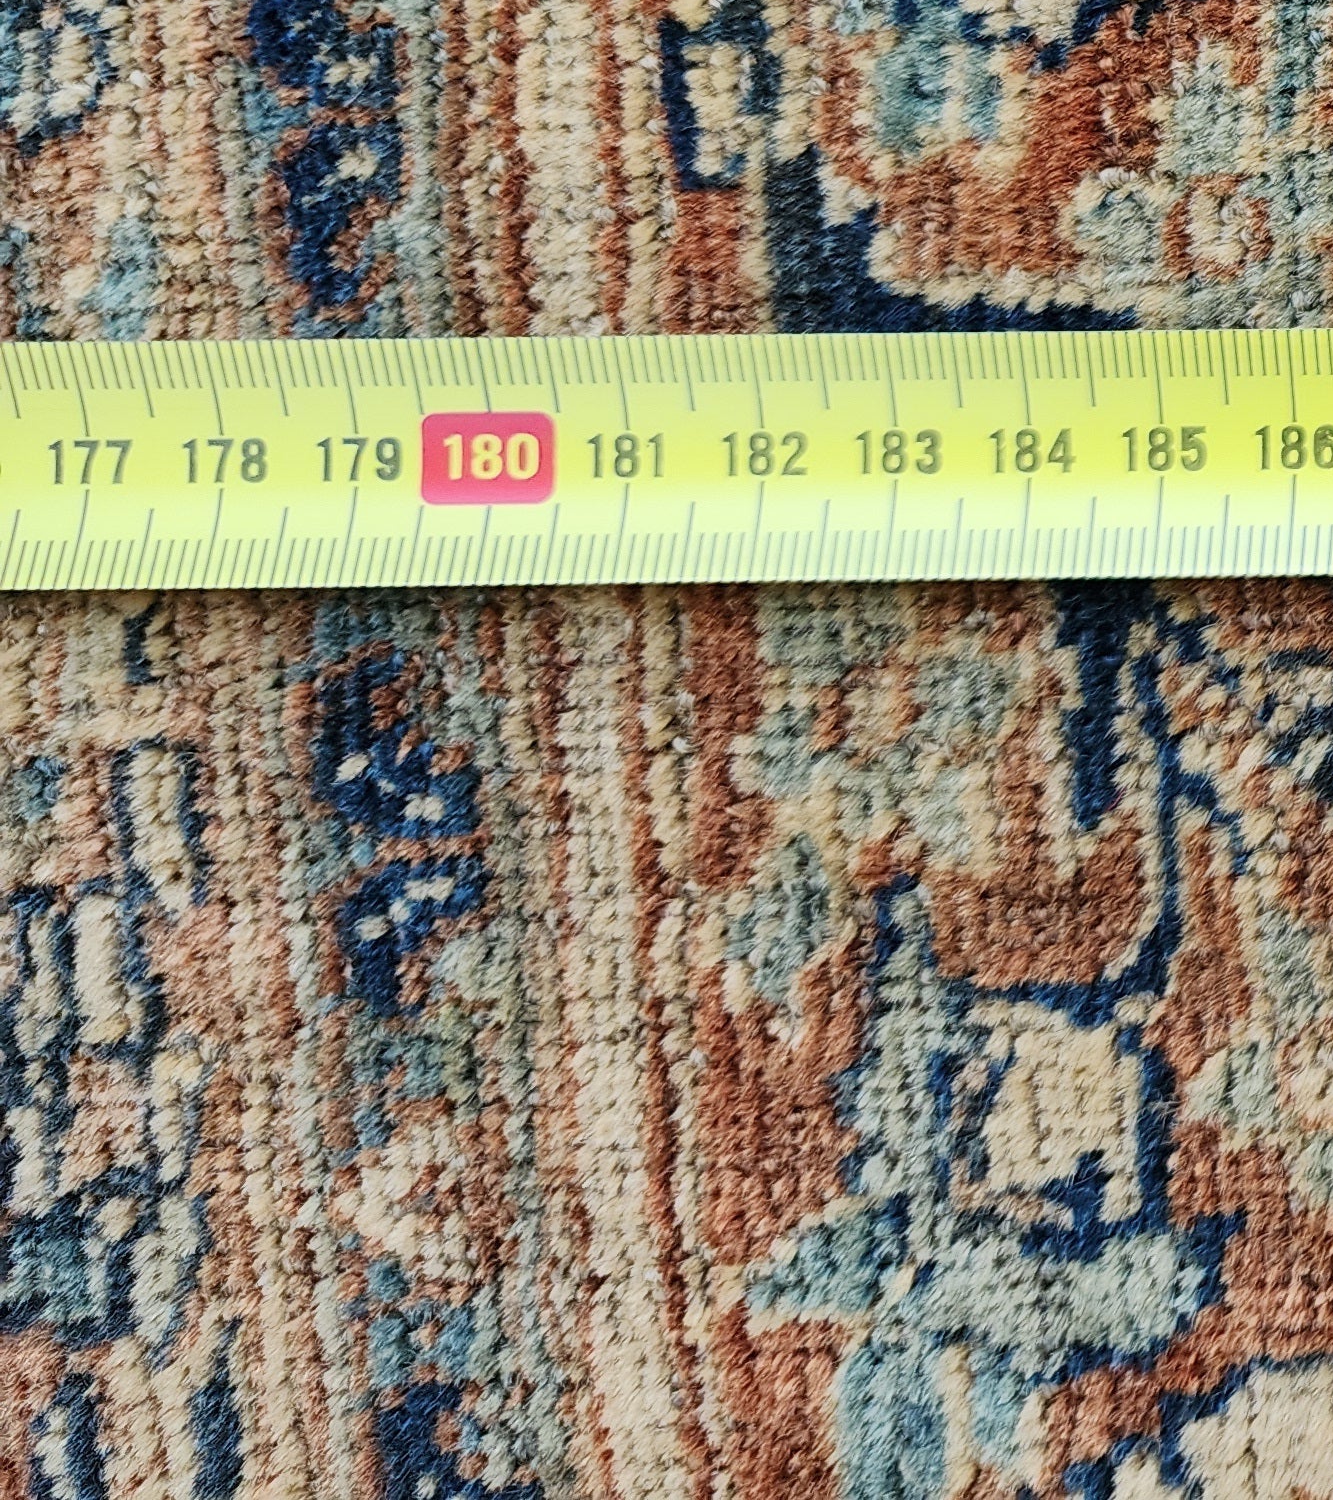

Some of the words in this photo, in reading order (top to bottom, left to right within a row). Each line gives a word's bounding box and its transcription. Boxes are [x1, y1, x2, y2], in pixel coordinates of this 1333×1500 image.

[47, 440, 133, 484] 177
[181, 439, 268, 484] 178
[316, 437, 401, 481] 179
[442, 434, 541, 480] 180
[587, 434, 664, 479] 181
[721, 431, 808, 477] 182
[854, 429, 943, 474] 183
[988, 428, 1076, 474] 184
[1121, 427, 1208, 472] 185
